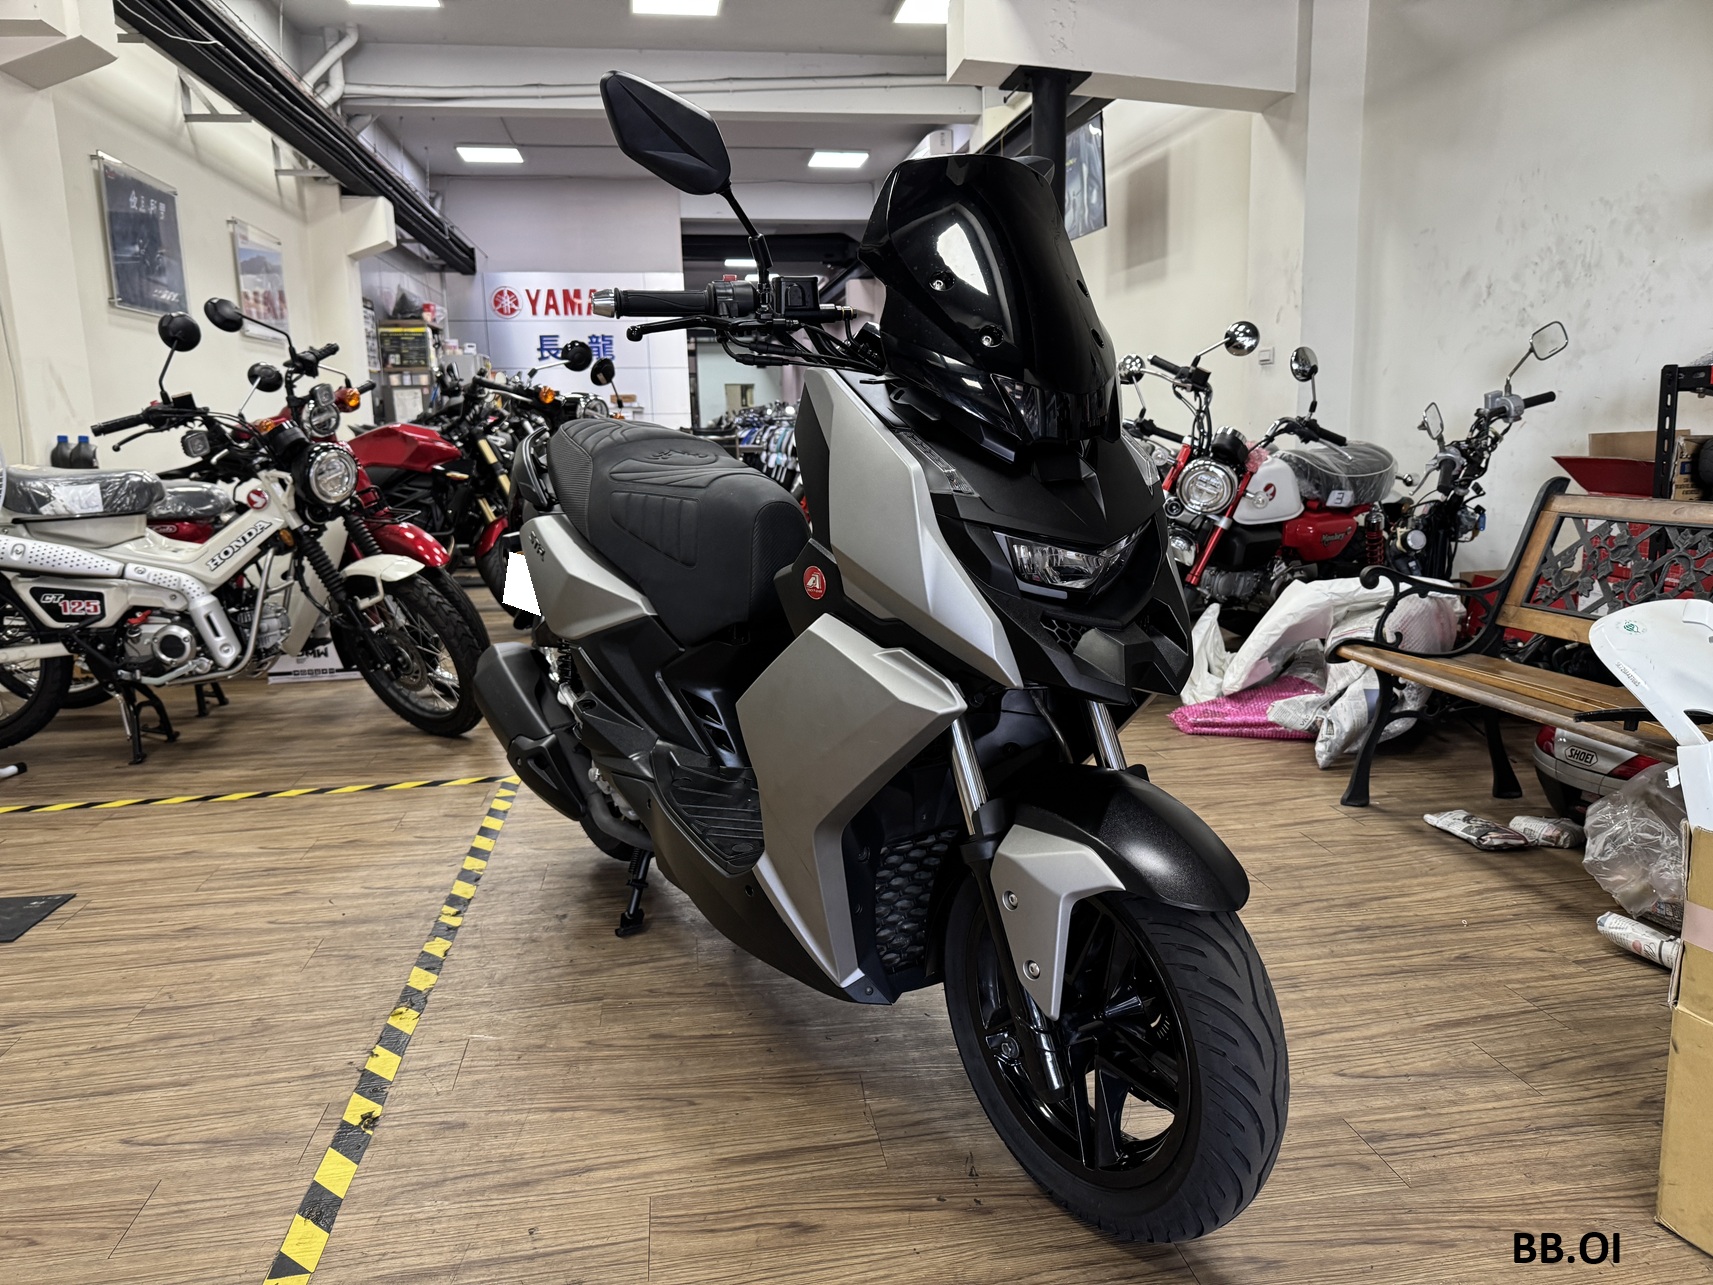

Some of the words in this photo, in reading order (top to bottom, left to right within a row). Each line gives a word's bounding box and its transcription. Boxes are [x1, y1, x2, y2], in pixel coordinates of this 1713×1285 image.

[206, 520, 273, 572] HONDA
[41, 593, 65, 603] CT
[58, 600, 101, 615] 125
[1568, 748, 1595, 764] SHOEI
